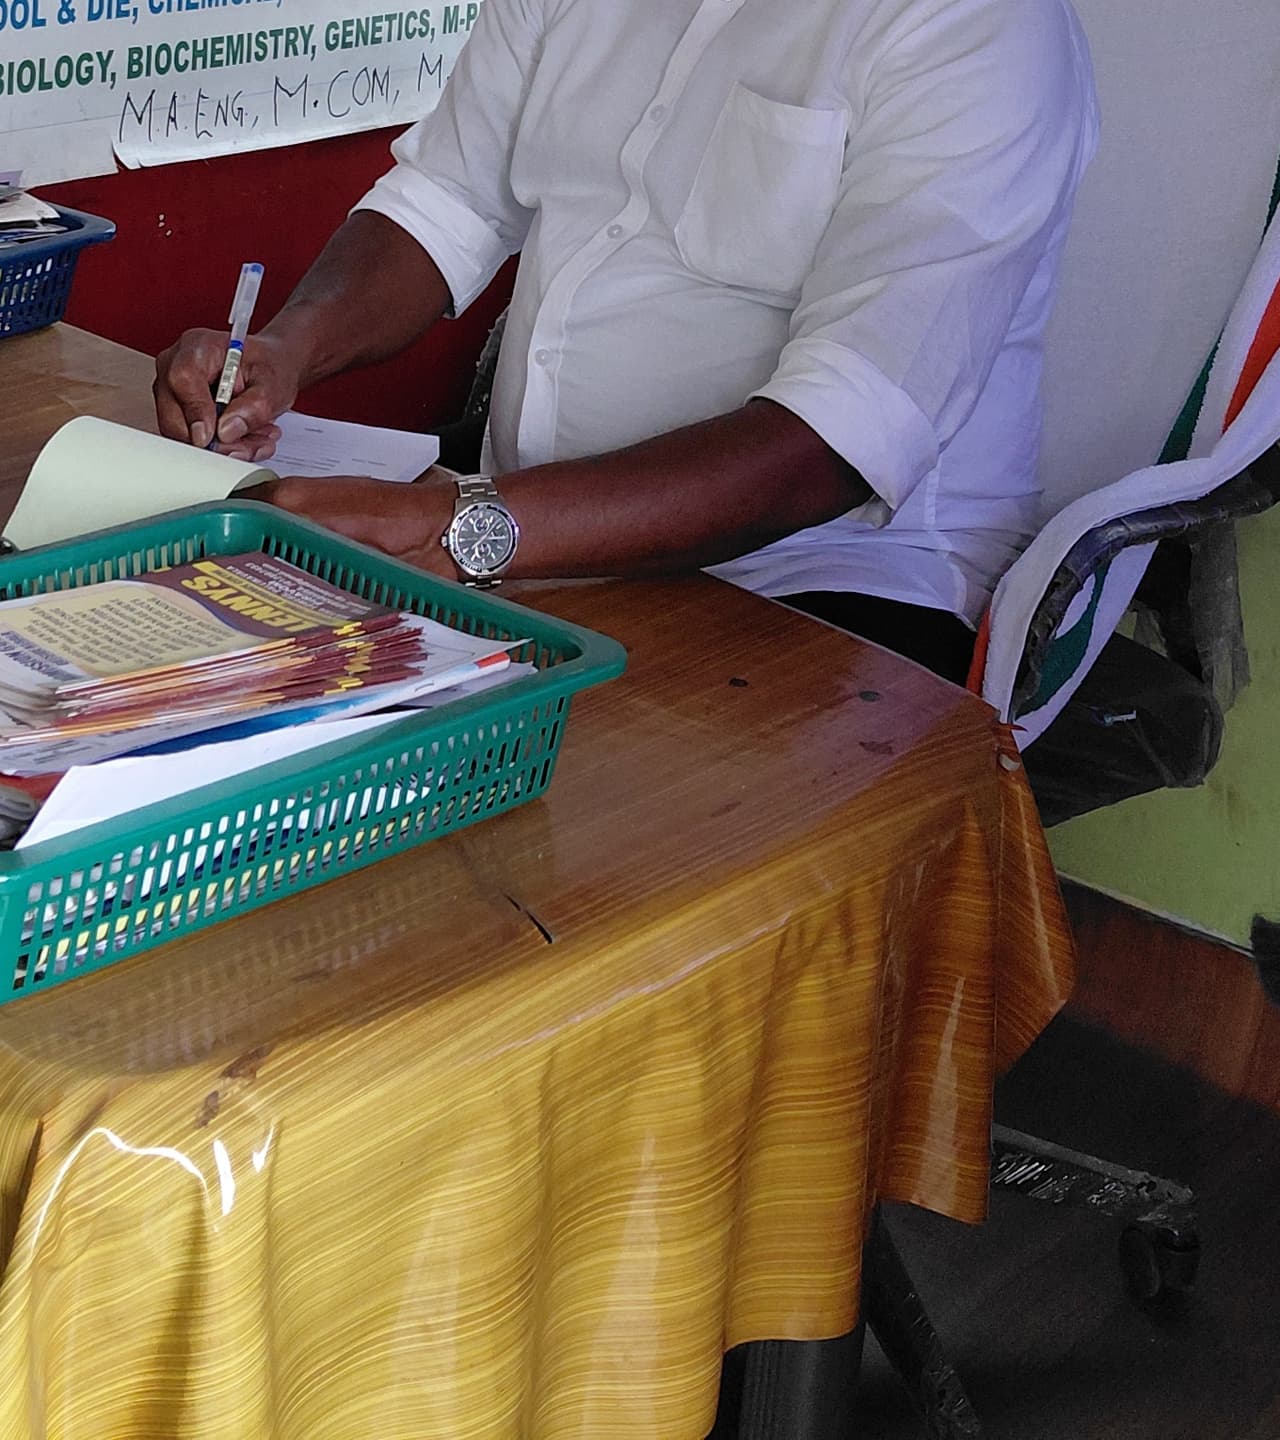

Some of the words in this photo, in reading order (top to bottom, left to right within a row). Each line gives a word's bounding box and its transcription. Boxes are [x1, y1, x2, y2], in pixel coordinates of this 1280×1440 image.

[125, 22, 317, 80] BIOCHEMISTRY,
[323, 9, 436, 52] GENETICS,
[178, 572, 321, 634] LENNYS
